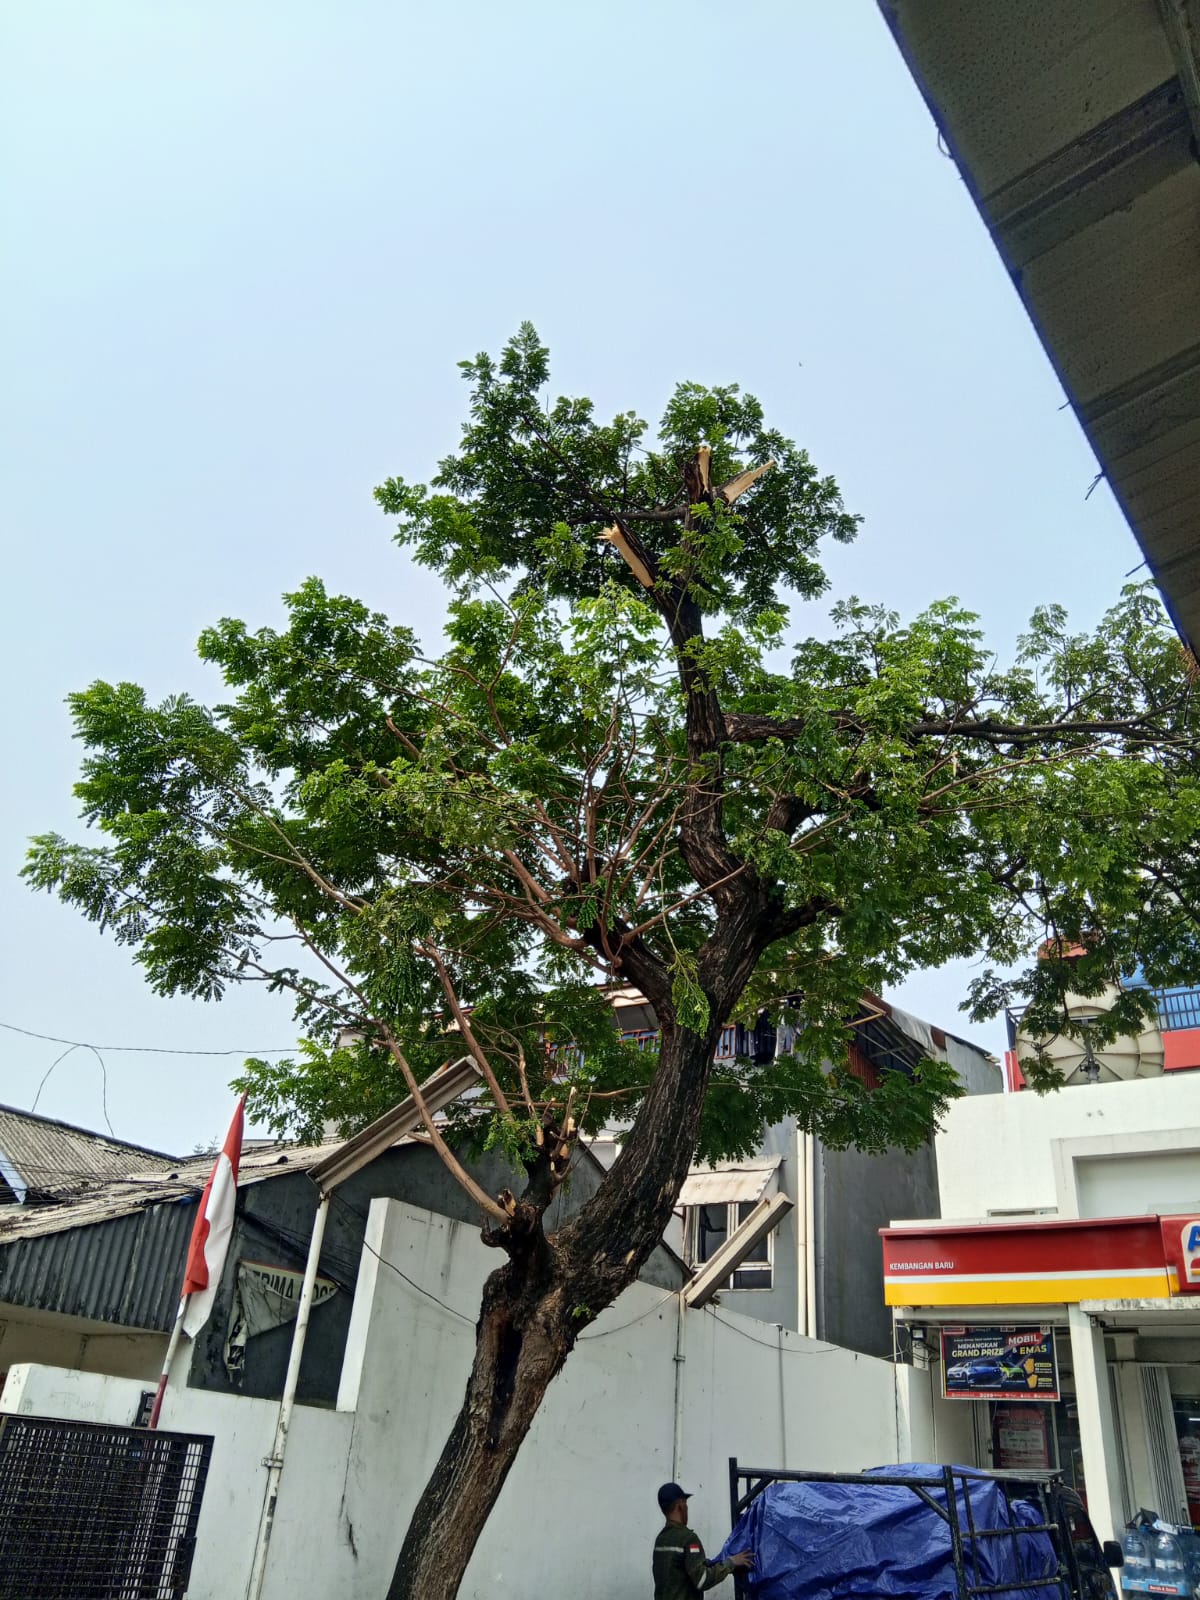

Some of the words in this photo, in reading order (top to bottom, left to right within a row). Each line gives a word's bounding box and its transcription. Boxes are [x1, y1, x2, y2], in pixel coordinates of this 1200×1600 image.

[889, 1262, 933, 1271] KEMBANGAN
[934, 1261, 954, 1270] BARU
[1008, 1334, 1040, 1345] MOBIL
[952, 1349, 980, 1358] GRAND
[981, 1347, 1004, 1356] PRIZE
[1019, 1344, 1047, 1355] EMAS
